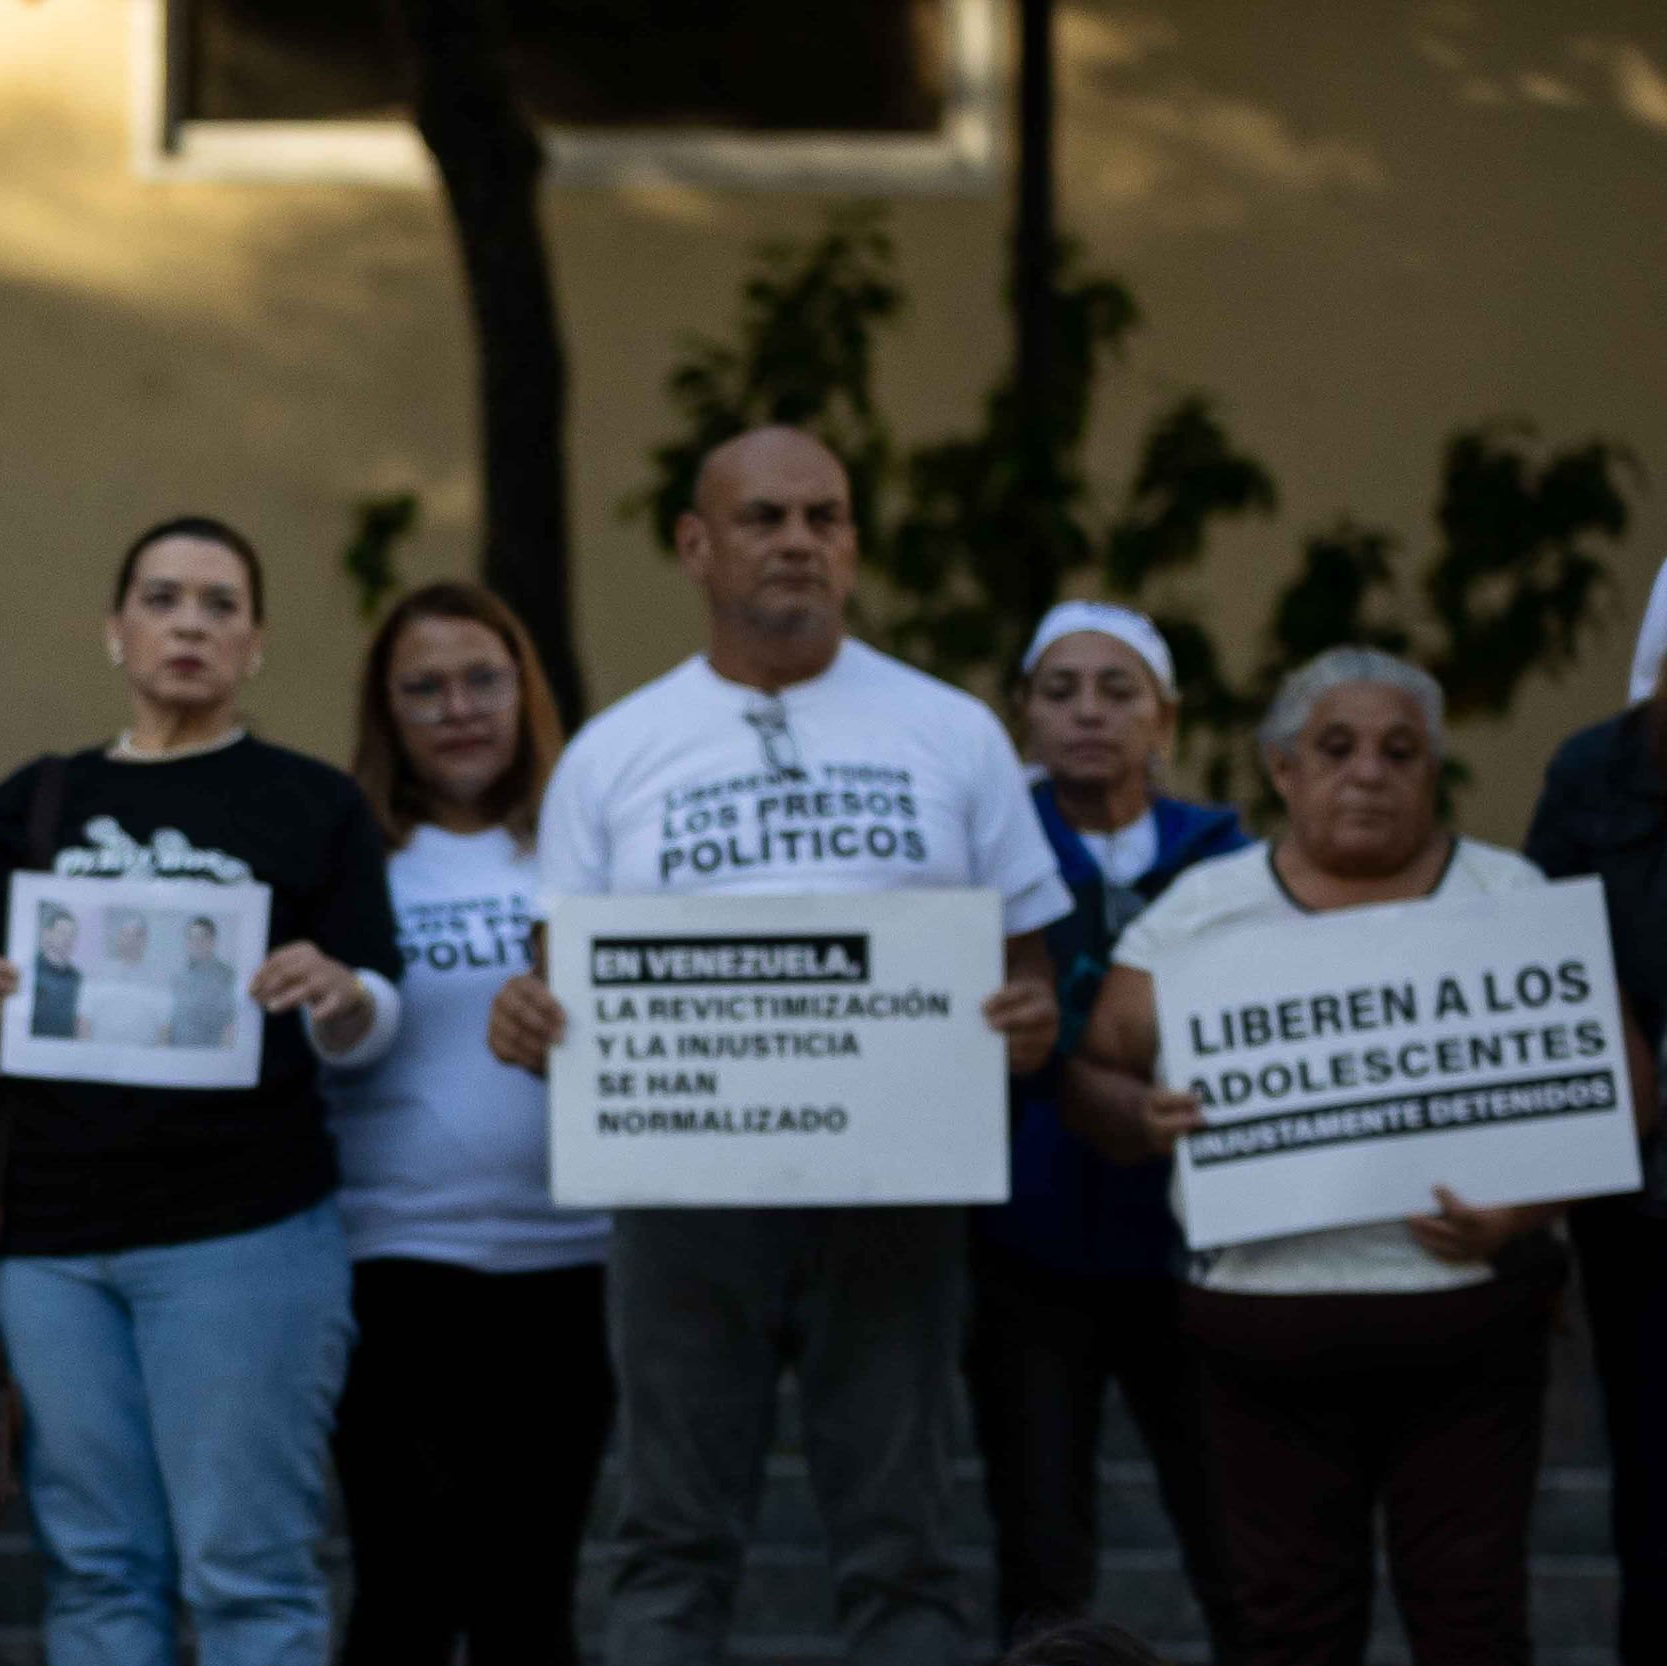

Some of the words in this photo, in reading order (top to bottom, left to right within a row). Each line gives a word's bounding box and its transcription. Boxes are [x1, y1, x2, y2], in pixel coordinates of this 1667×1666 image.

[595, 992, 644, 1024] LA
[648, 988, 950, 1023] REVICTIMIZACIÓN
[1187, 981, 1431, 1059] LIBEREN
[1433, 977, 1469, 1021] A
[1481, 959, 1592, 1015] LOS
[596, 1034, 618, 1060] Y
[625, 1033, 667, 1060] LA
[676, 1031, 860, 1060] INJUSTICIA
[1187, 1018, 1607, 1110] ADOLESCENTES
[596, 1071, 638, 1100] SE
[647, 1070, 719, 1099] HAN
[596, 1105, 849, 1138] NORMALIZADO
